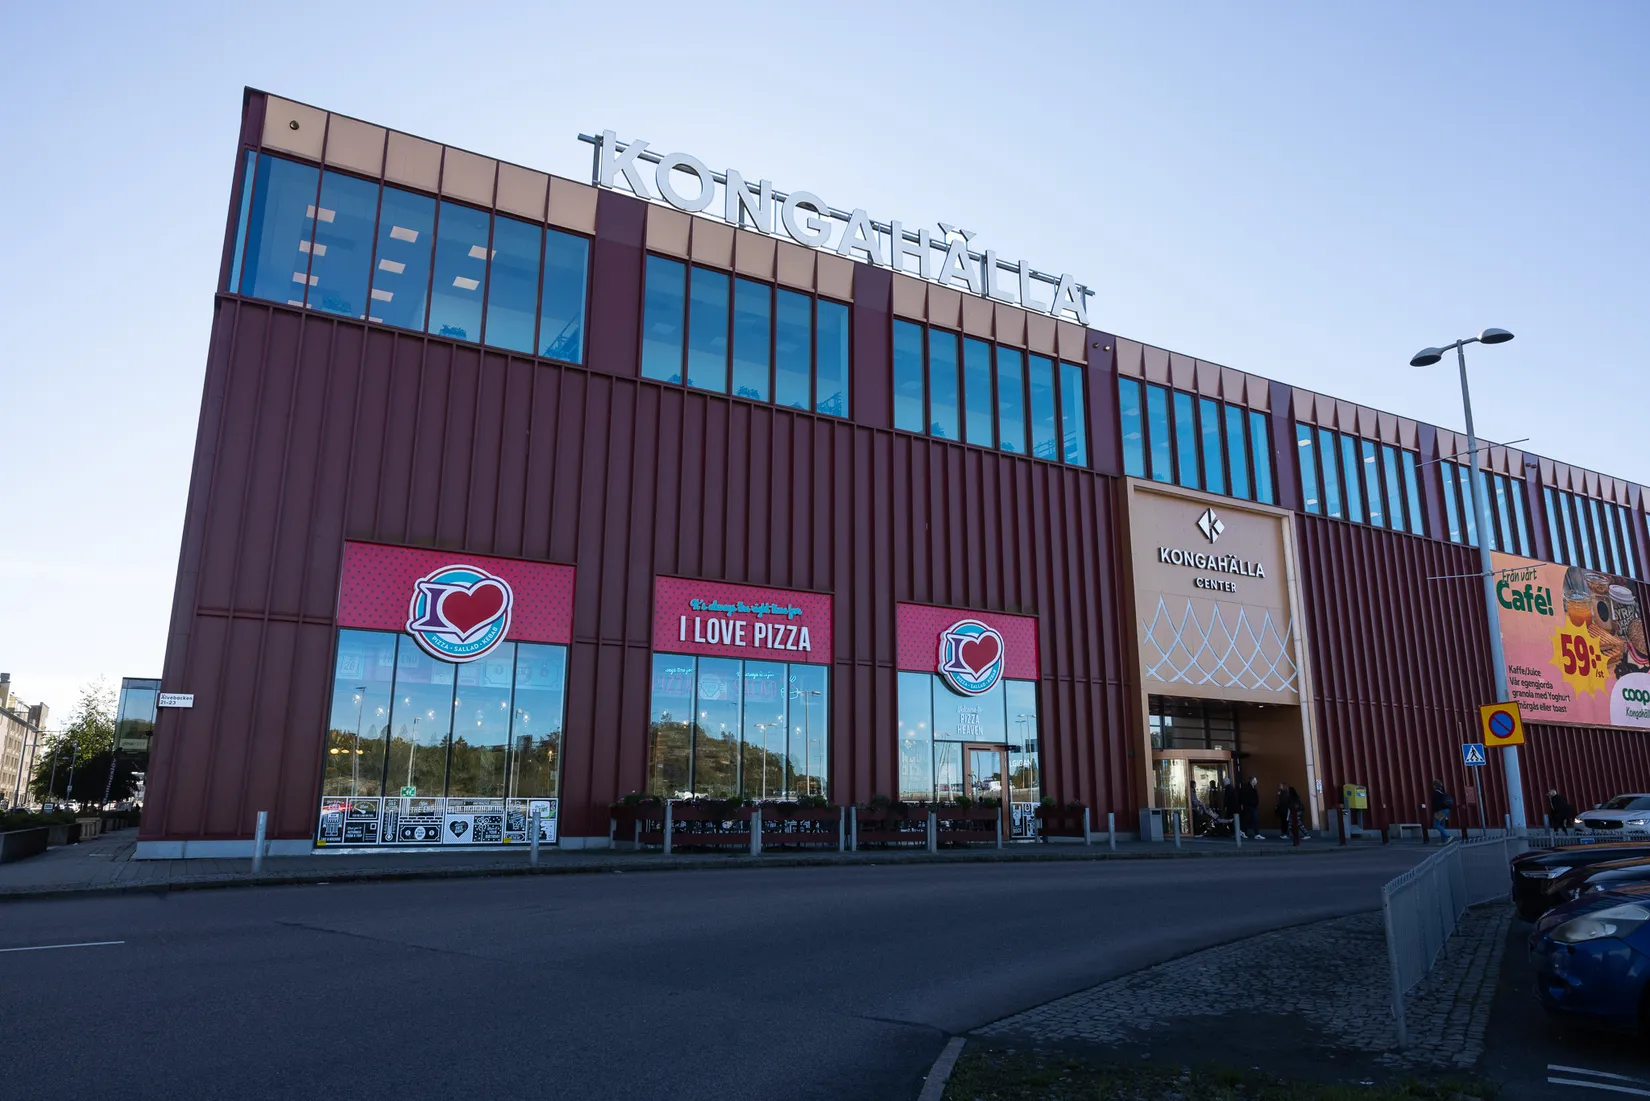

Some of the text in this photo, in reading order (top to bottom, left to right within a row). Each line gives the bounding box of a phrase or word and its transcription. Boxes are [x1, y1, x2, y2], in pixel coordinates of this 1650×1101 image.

[600, 129, 1090, 325] KONGAHÄLLA
[1158, 546, 1266, 578] KONGAHÄLLA
[1520, 568, 1537, 581] vårt
[1194, 577, 1237, 592] CENTER
[1496, 579, 1554, 616] Café!
[432, 626, 498, 652] PIZZA SALLAD KEBAB
[680, 615, 811, 651] I LOVE PIZZA
[1560, 633, 1601, 676] 59:-
[1508, 665, 1542, 677] Kaffe/Juice
[956, 675, 967, 686] PIZZA
[970, 681, 986, 689] SALLAD
[1510, 677, 1554, 690] Vår egengjorda
[1512, 690, 1571, 703] granola med Yoghurt
[1622, 688, 1650, 705] coop
[1518, 701, 1539, 712] mörgås
[1553, 705, 1567, 713] toast
[960, 714, 980, 724] PIZZA
[957, 725, 984, 735] HEAVEN
